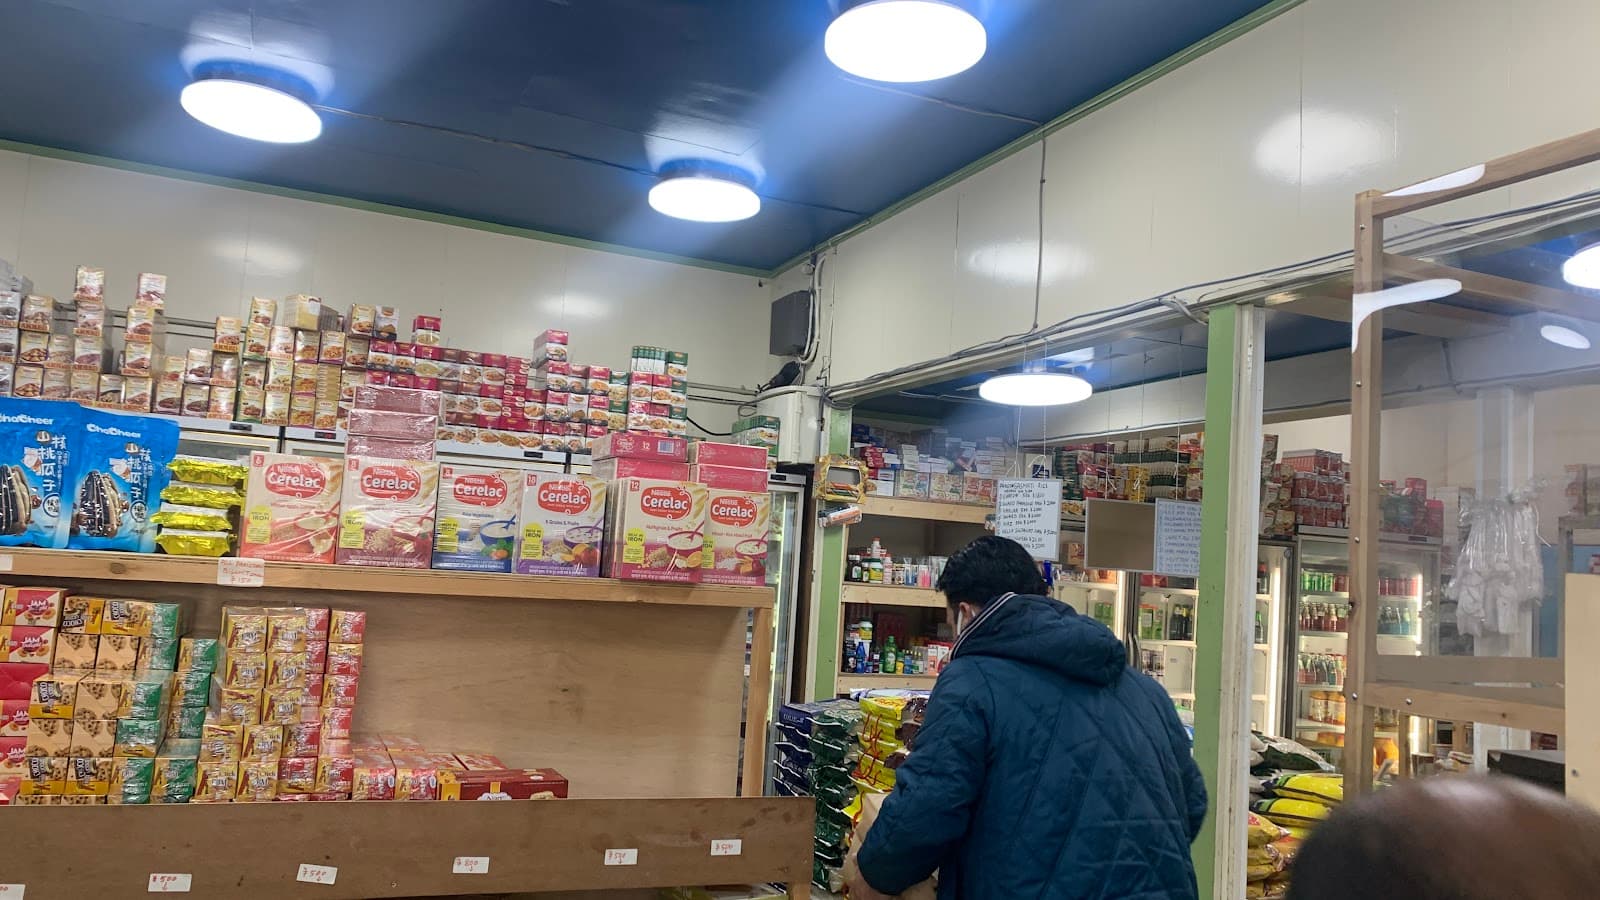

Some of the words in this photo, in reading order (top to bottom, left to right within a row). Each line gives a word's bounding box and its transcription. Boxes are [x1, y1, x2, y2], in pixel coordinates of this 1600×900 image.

[86, 423, 142, 438] ChaCheer
[268, 472, 321, 488] Cerelac
[362, 475, 416, 490] Cerelac
[527, 474, 536, 483] 18
[630, 481, 639, 489] 12
[455, 483, 503, 498] Cerelac
[540, 490, 587, 505] Cerelac
[642, 495, 689, 510] Cerelac
[712, 504, 753, 518] Cerelac
[30, 599, 48, 607] JAM
[23, 636, 41, 644] JAM
[39, 682, 48, 701] CHOCO
